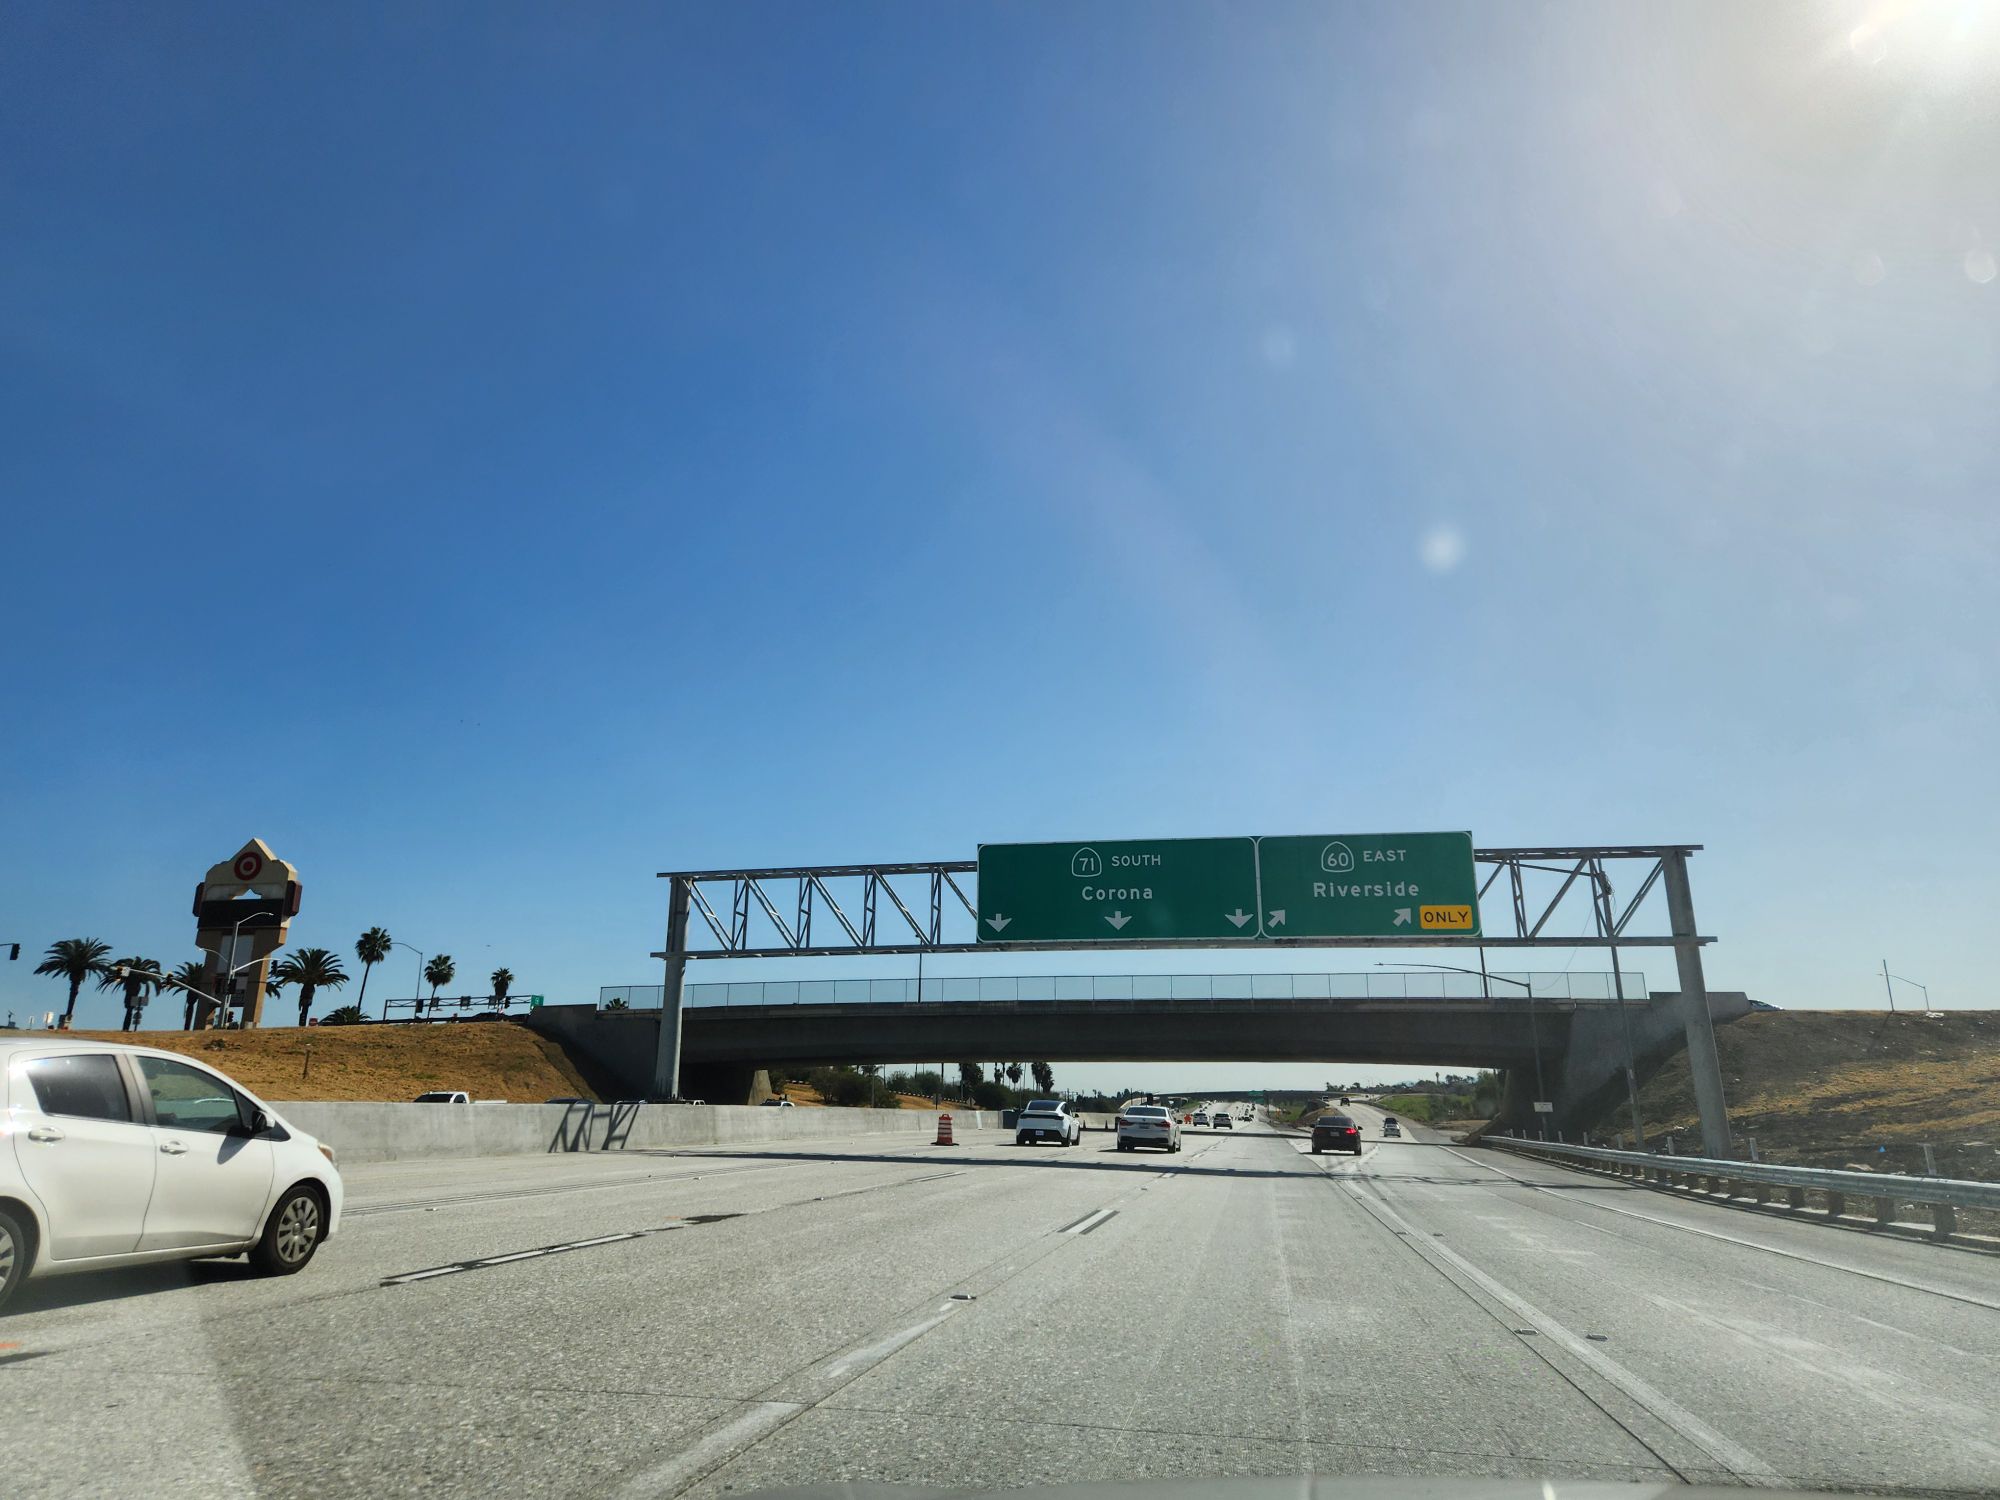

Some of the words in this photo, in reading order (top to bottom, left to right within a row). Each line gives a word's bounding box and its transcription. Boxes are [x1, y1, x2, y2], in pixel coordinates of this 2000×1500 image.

[1079, 857, 1095, 872] 71
[1111, 854, 1161, 867] SOUTH
[1327, 852, 1349, 867] 60
[1363, 849, 1407, 862] EAST
[1081, 886, 1153, 901] Corona
[1313, 881, 1419, 898] Riverside
[1423, 911, 1468, 923] ONLY
